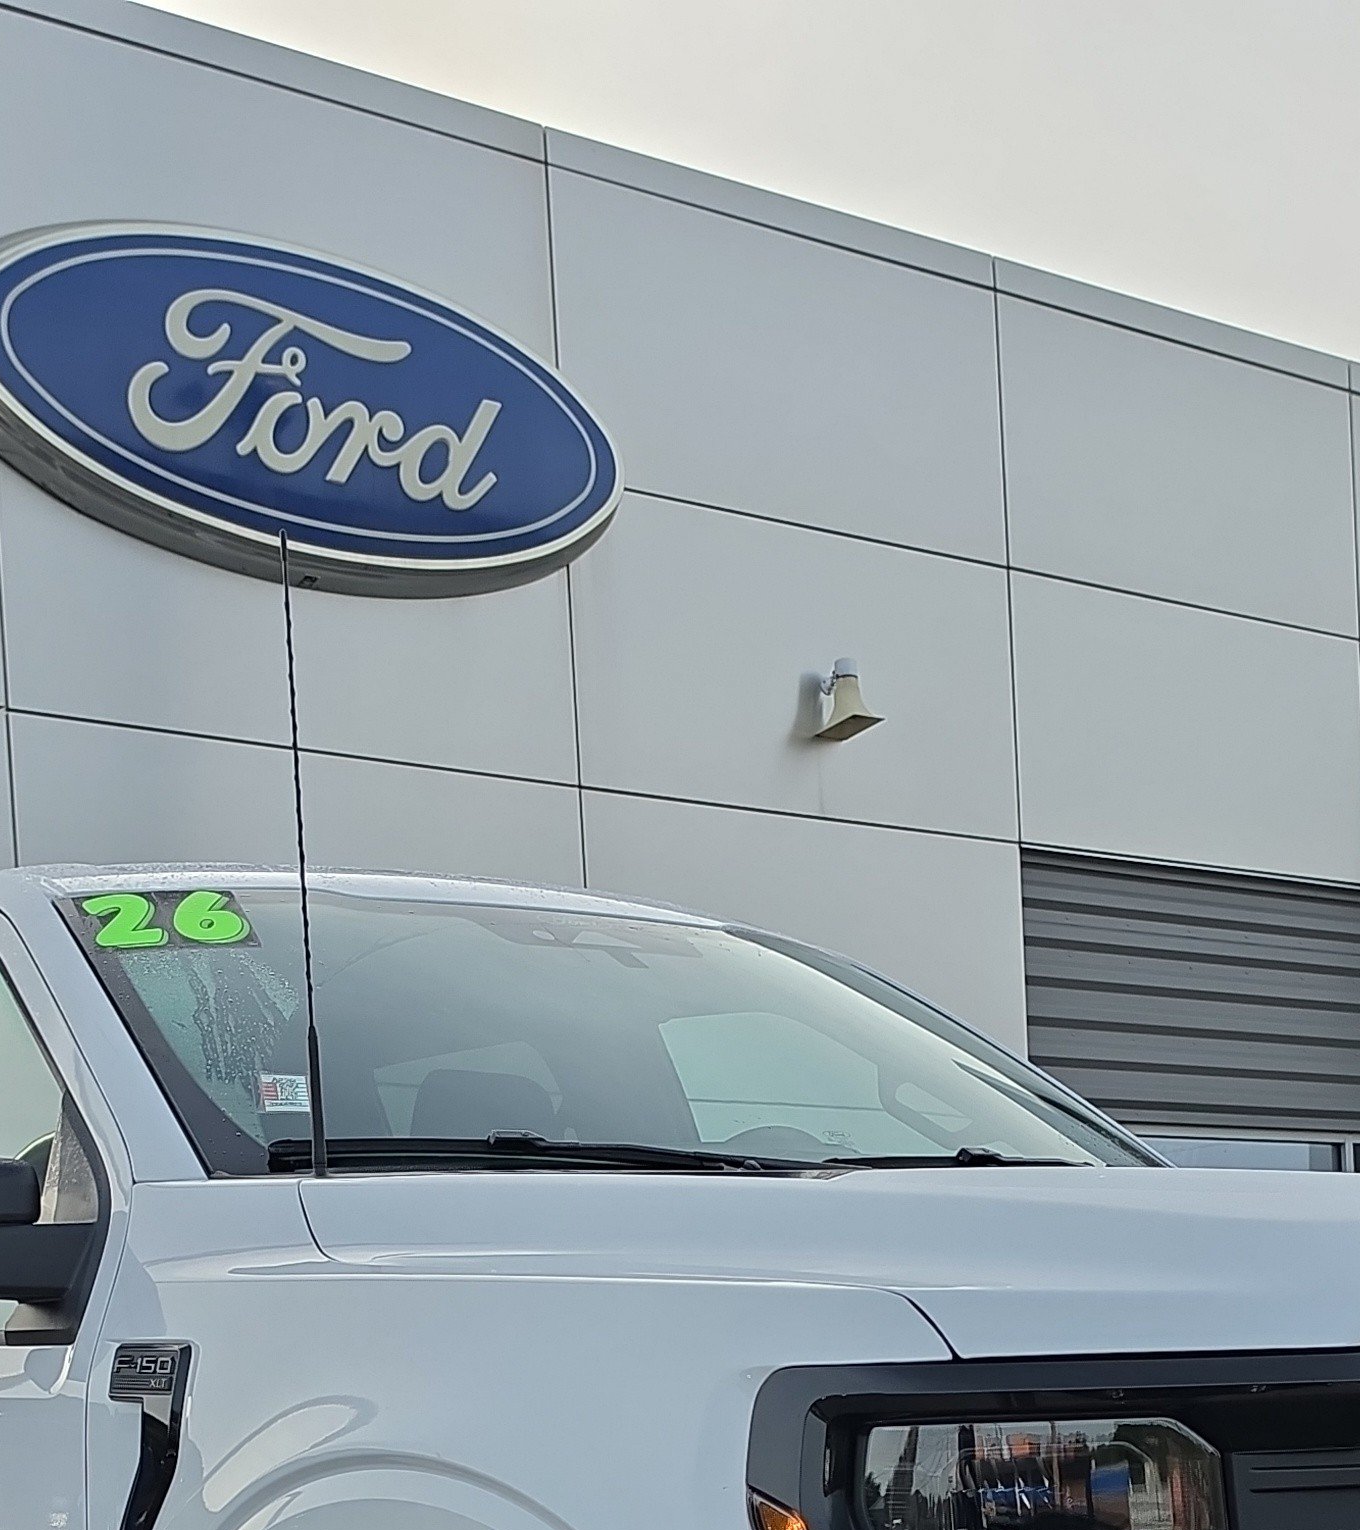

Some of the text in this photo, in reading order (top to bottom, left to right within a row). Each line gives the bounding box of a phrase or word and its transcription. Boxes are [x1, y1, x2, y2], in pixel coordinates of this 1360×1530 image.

[126, 287, 503, 511] Ford
[82, 890, 251, 948] 26
[114, 1357, 171, 1373] F-150
[149, 1378, 167, 1388] XLT
